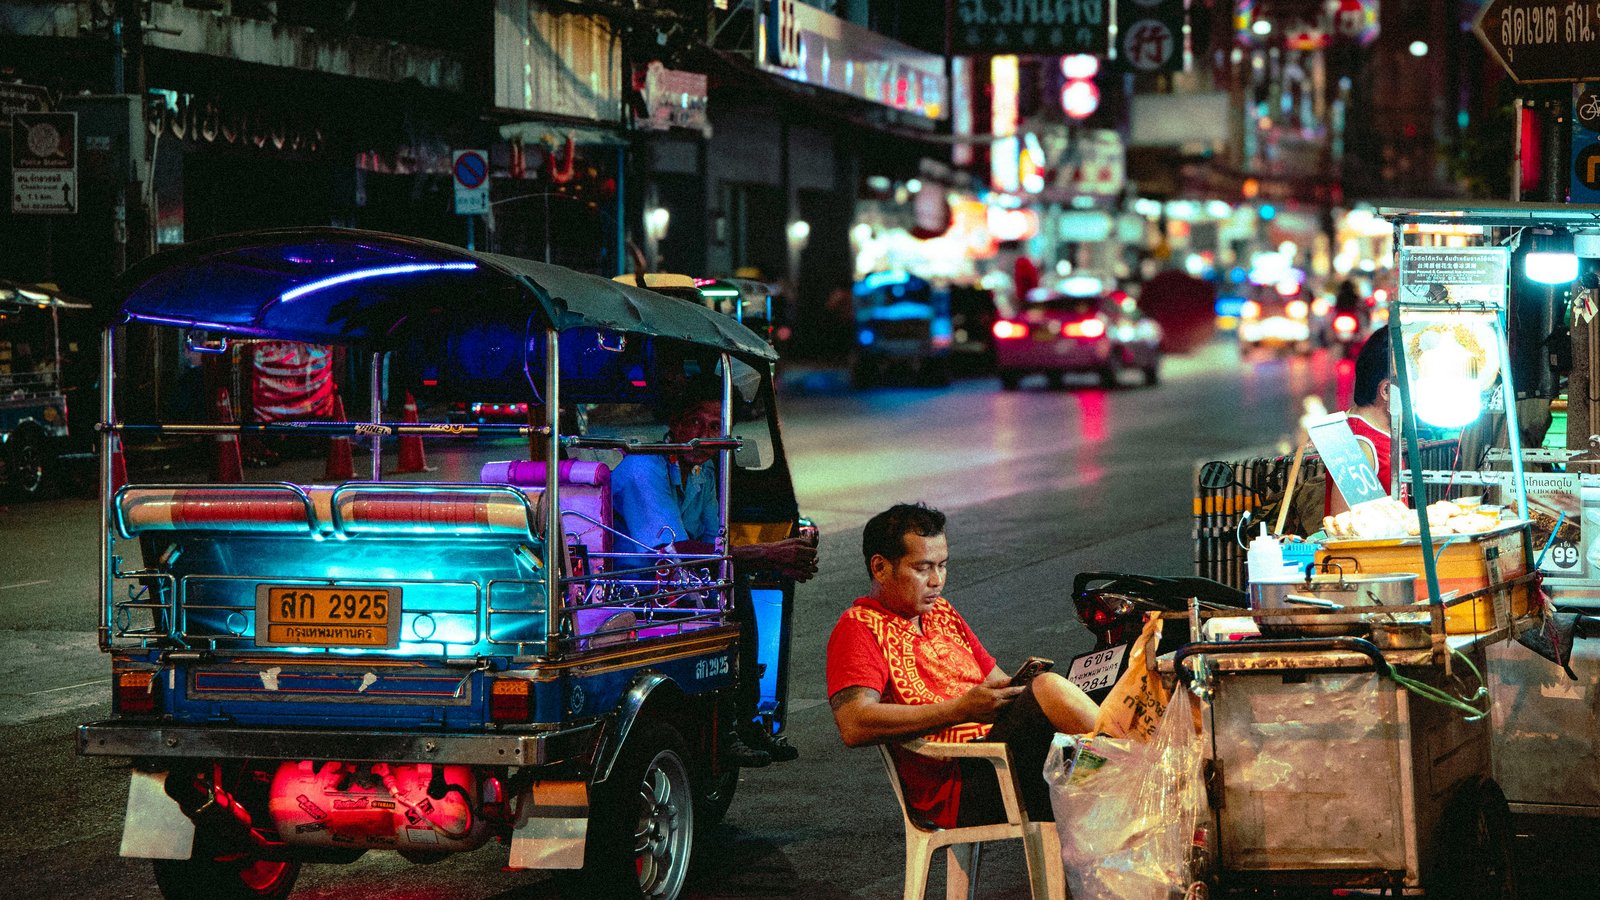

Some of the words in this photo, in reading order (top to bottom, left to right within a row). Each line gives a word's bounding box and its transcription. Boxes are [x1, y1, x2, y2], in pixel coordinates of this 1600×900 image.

[1501, 5, 1557, 62] สุดเขต
[1554, 546, 1577, 563] 99
[281, 591, 314, 619] สก
[328, 594, 387, 619] 2925
[286, 626, 372, 641] กรุงเทพมหานคร
[1076, 674, 1109, 692] 284
